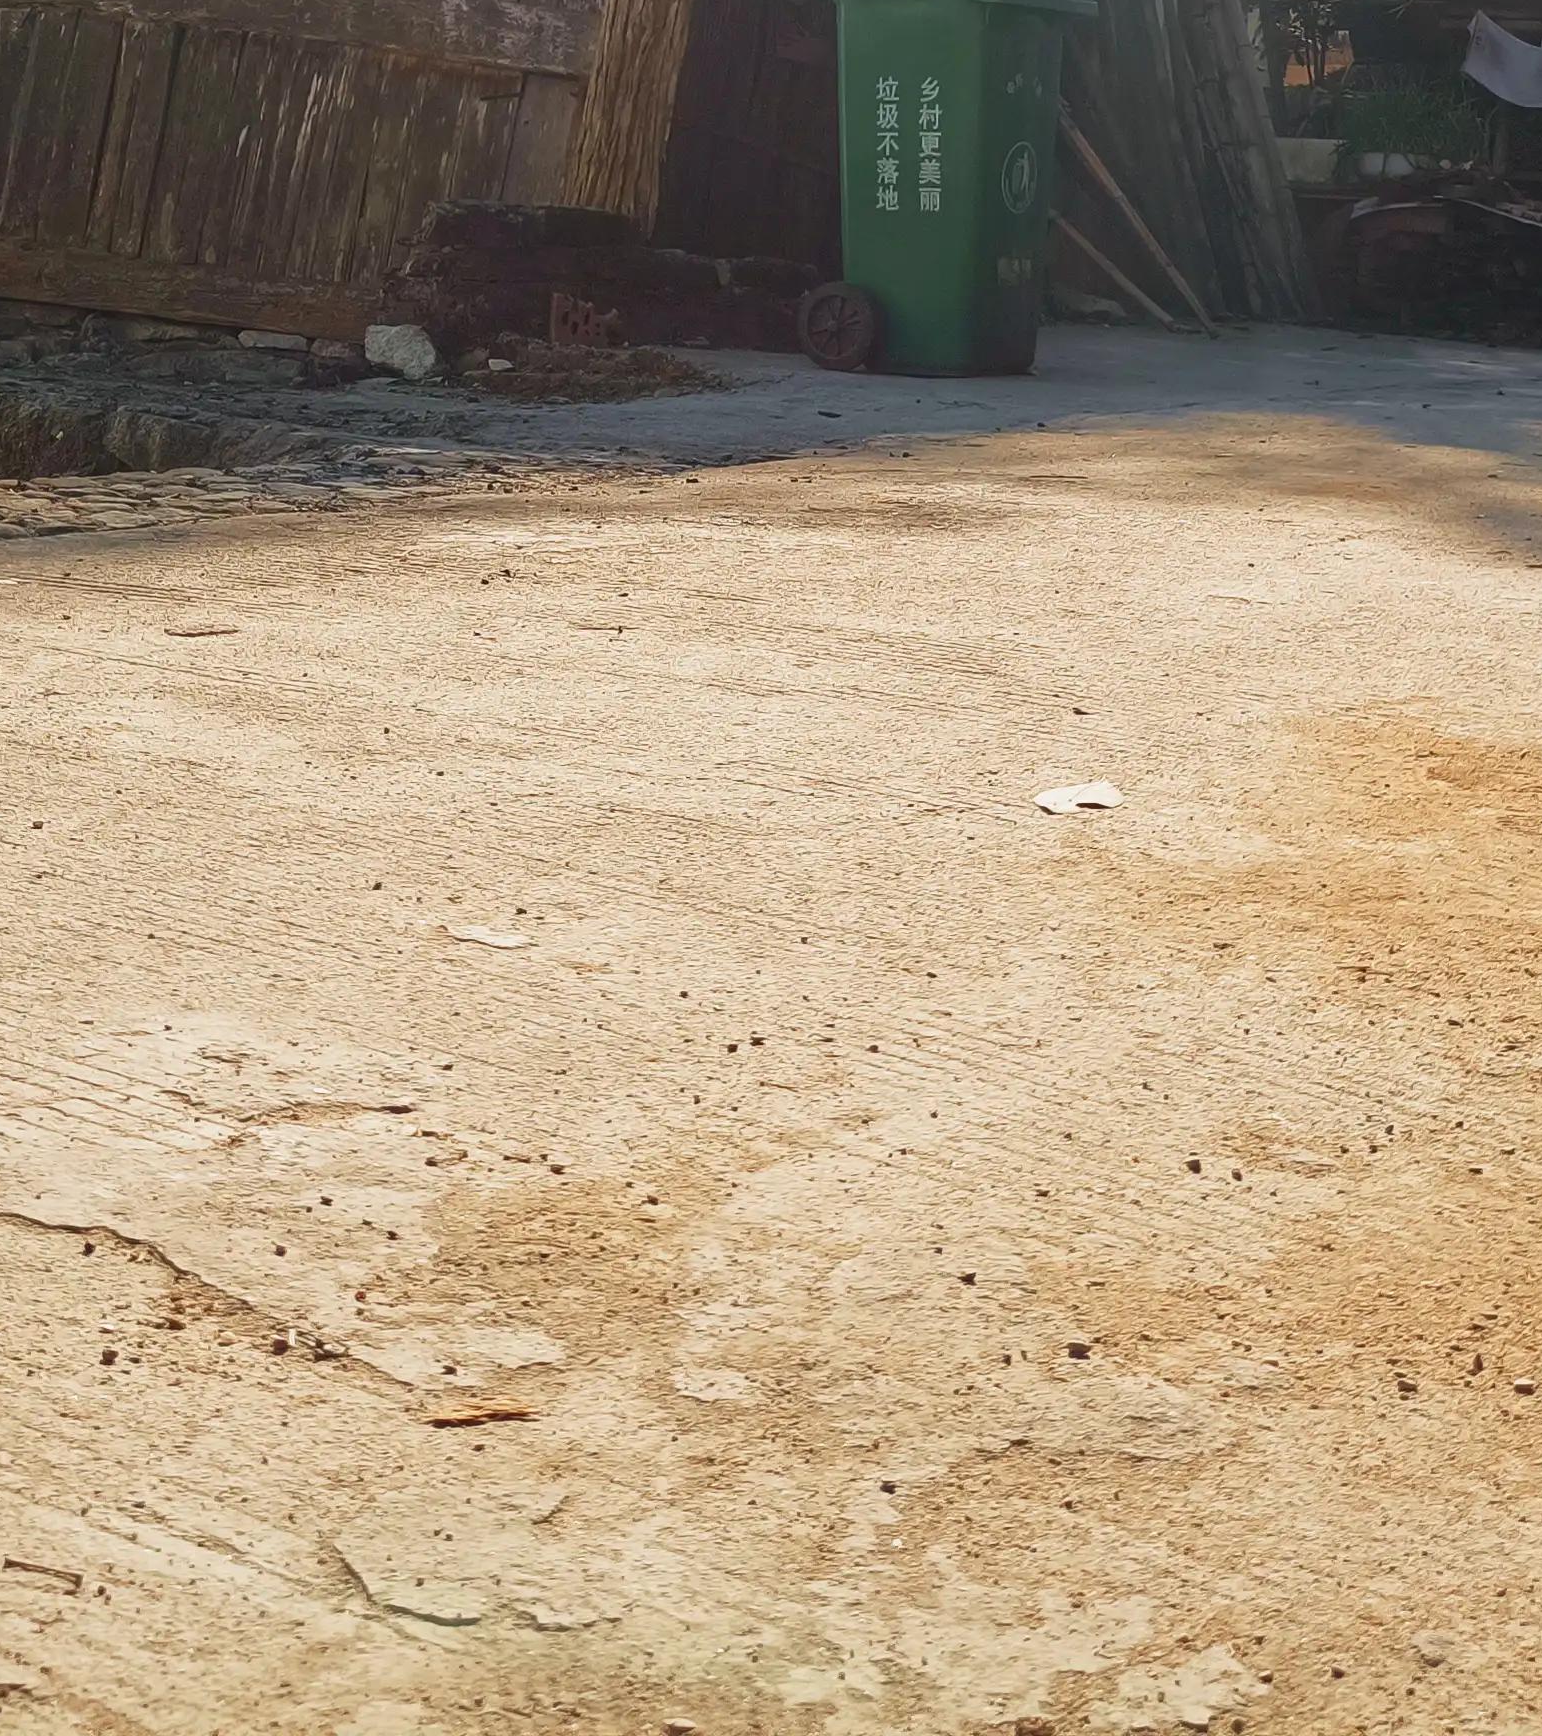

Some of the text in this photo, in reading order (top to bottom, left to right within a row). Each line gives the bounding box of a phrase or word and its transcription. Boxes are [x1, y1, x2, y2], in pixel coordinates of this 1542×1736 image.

[876, 76, 899, 211] 垃圾不落地
[919, 76, 942, 212] 乡村更美丽
